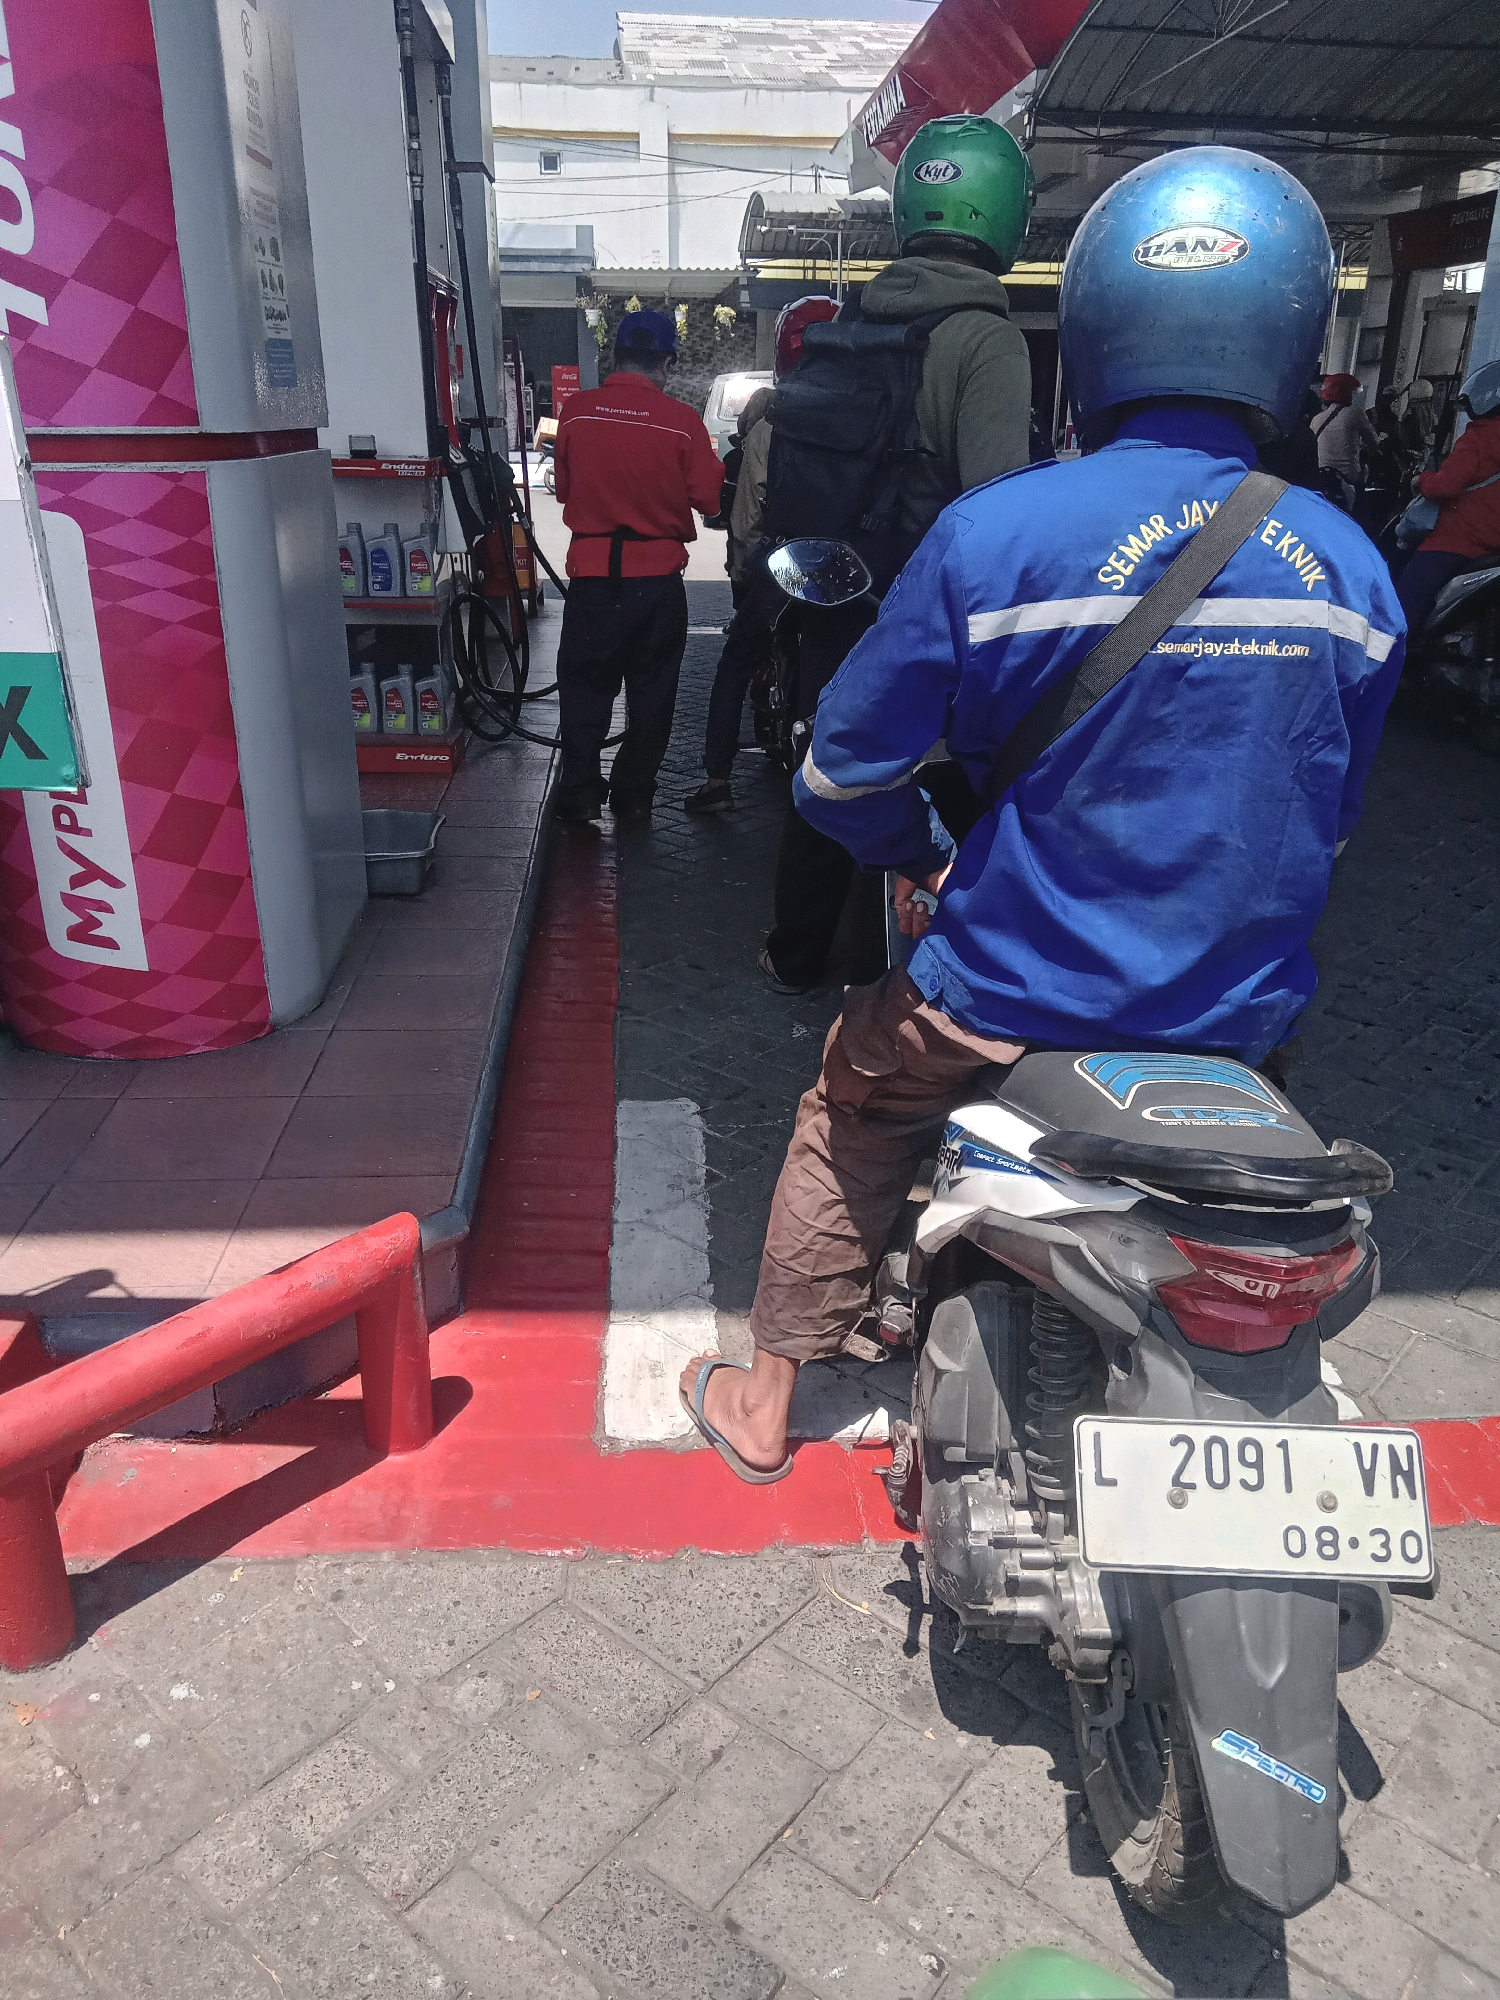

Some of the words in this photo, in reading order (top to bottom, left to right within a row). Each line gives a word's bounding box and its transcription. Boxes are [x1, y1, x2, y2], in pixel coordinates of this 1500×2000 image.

[381, 462, 426, 470] Enduro
[1097, 514, 1174, 591] SEMAR
[1175, 499, 1220, 531] JAY
[1250, 516, 1327, 592] EKNIK
[395, 752, 450, 761] Enduro
[1094, 1431, 1118, 1487] L
[1169, 1433, 1293, 1494] 2091
[1353, 1441, 1417, 1500] VN
